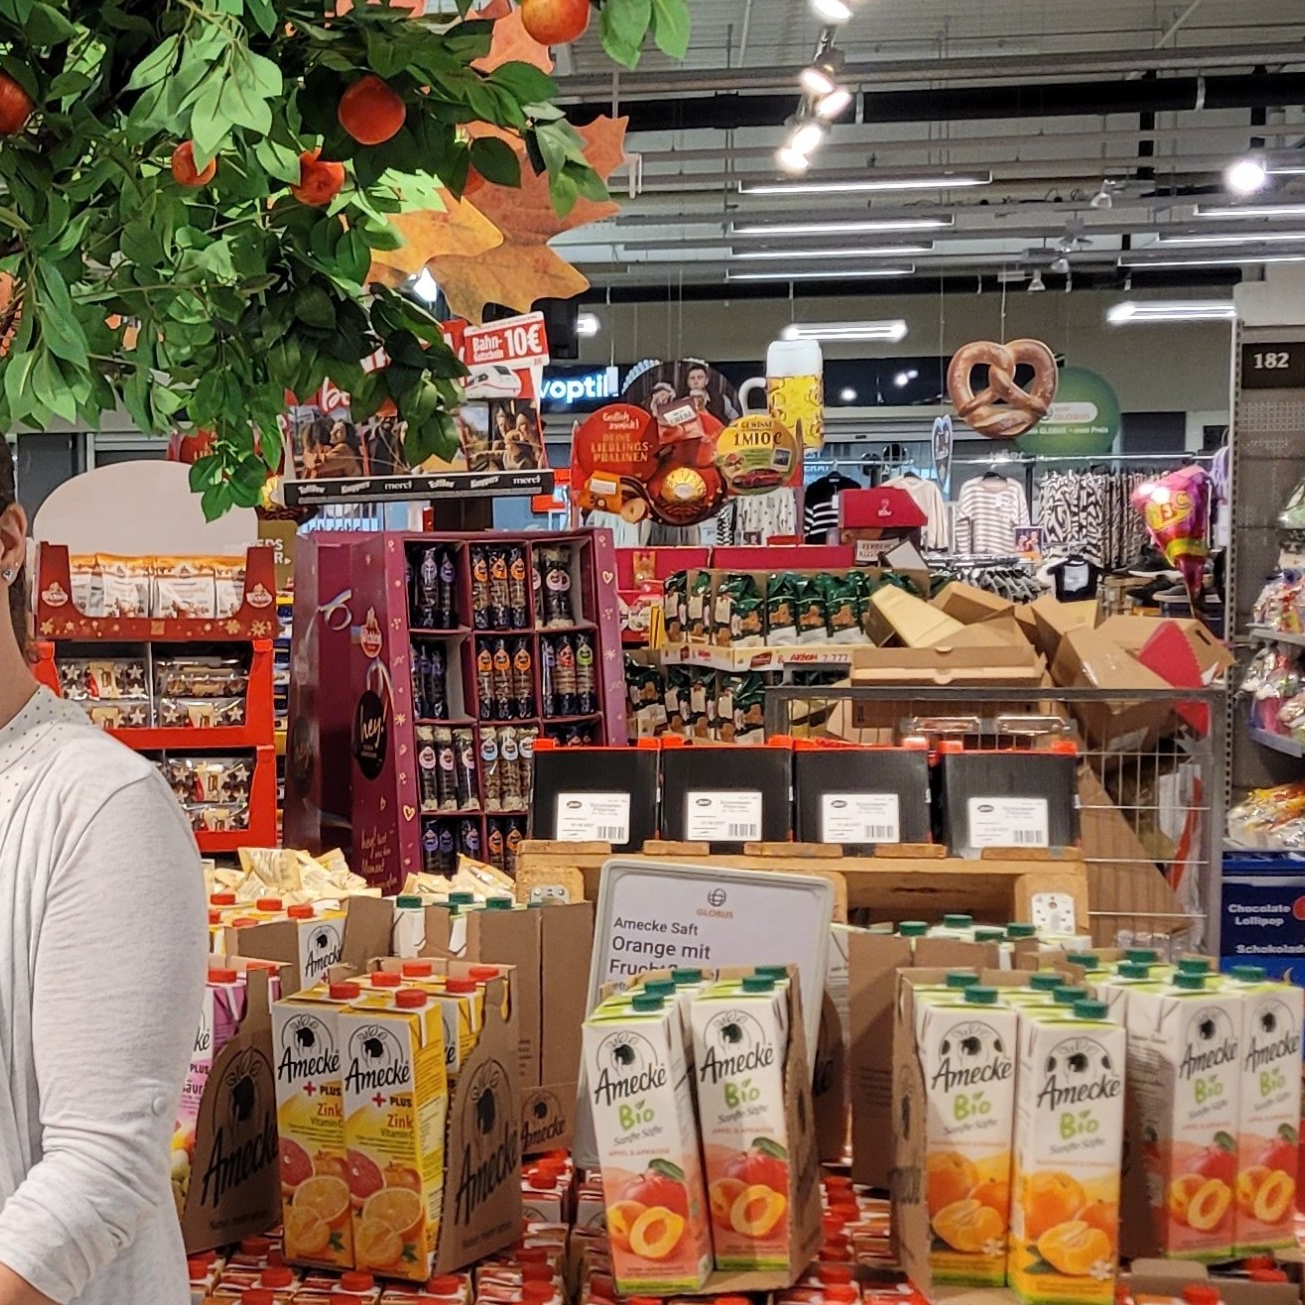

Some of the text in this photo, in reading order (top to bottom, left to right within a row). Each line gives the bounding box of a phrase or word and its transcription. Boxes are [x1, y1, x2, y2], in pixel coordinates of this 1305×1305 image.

[505, 323, 542, 358] 10€
[1253, 352, 1290, 369] 182
[590, 442, 654, 453] LIEBLINGS-
[593, 451, 648, 463] PRALINEN
[385, 480, 413, 490] merci
[513, 475, 541, 485] merci
[359, 702, 387, 749] hey!
[696, 908, 734, 919] GLOBUS
[1227, 903, 1292, 915] Chocolate
[1235, 915, 1285, 928] Lollipop
[613, 916, 699, 936] Amecke Saft
[612, 935, 711, 960] Orange mit
[1236, 942, 1305, 955] Schokolad
[278, 1046, 340, 1084] Amecke
[346, 1060, 411, 1094] Amecke
[700, 1042, 775, 1085] Amecke
[932, 1055, 1013, 1093] Amecke
[319, 1086, 342, 1097] PLUS
[595, 1063, 667, 1107] Amecke
[723, 1078, 761, 1110] Bio
[1037, 1073, 1121, 1111] Amecke
[1195, 1073, 1224, 1104] Bio
[1259, 1068, 1287, 1098] Bio
[316, 1102, 342, 1118] Zink
[389, 1096, 412, 1108] PLUS
[618, 1100, 655, 1131] Bio
[953, 1091, 992, 1121] Bio
[387, 1113, 414, 1130] Zink
[1059, 1109, 1099, 1140] Bio
